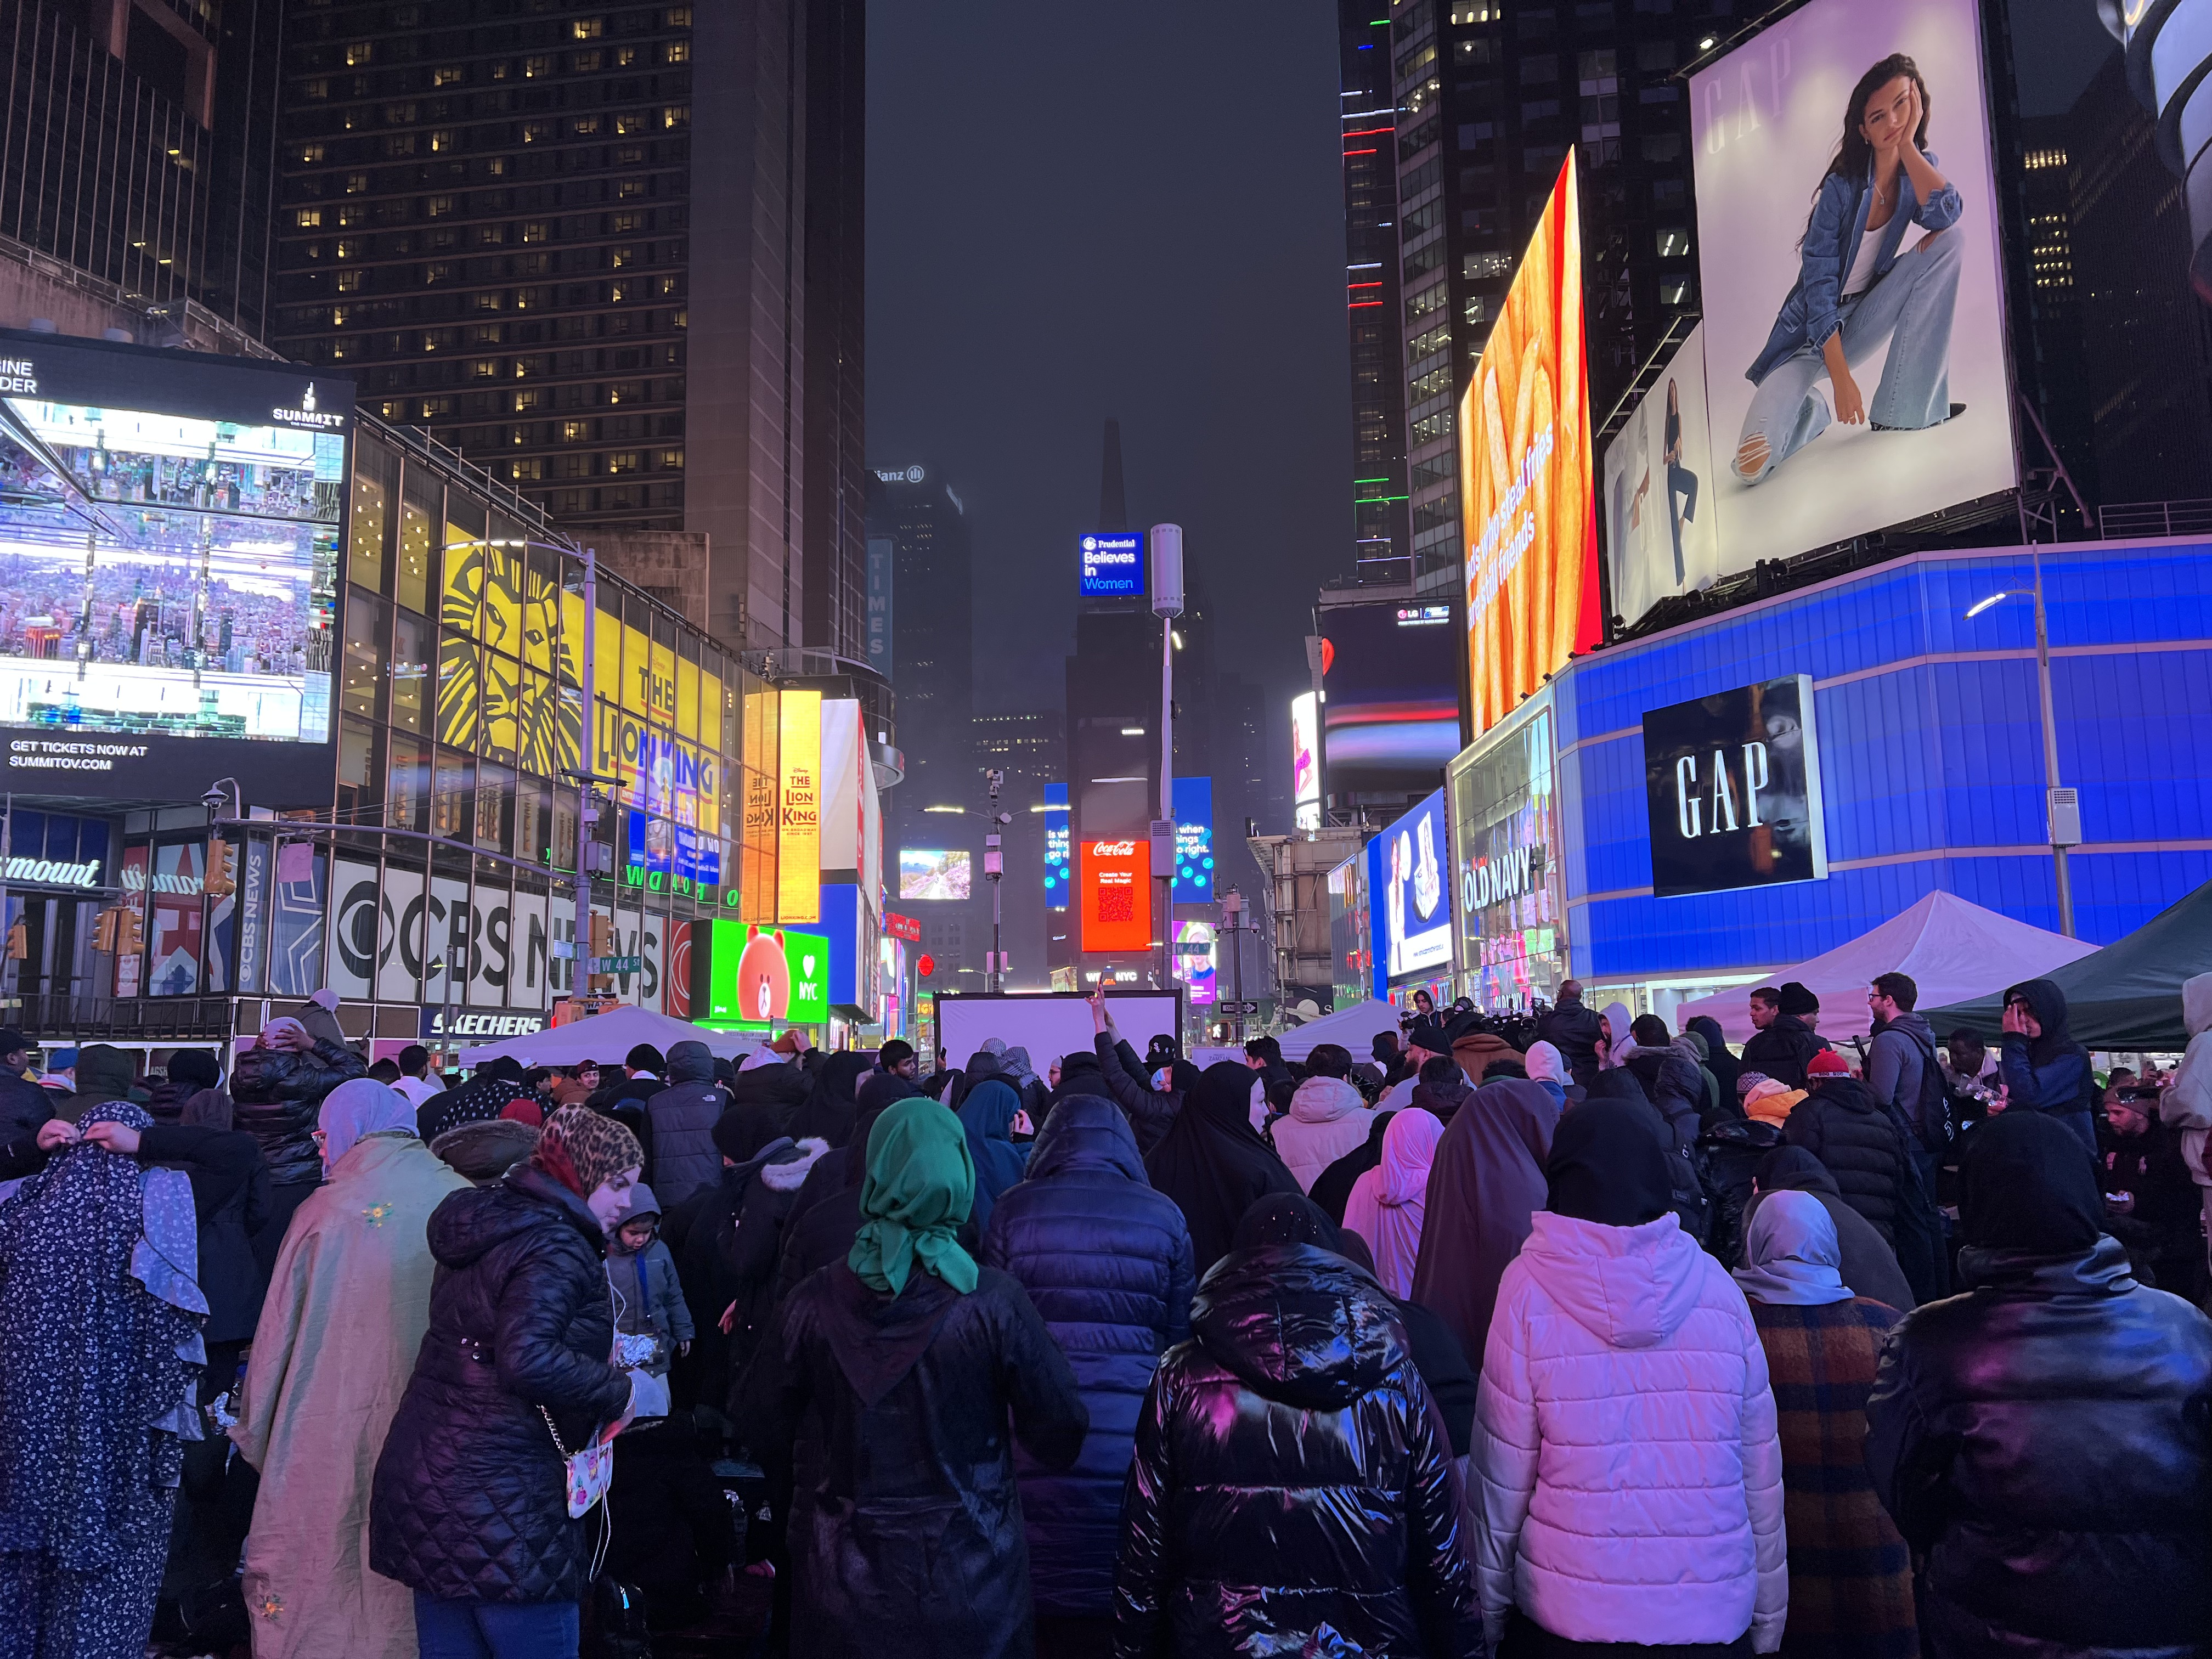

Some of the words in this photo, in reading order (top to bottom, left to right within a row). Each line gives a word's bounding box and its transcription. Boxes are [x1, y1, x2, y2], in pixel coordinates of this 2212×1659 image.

[1704, 38, 1791, 154] GAP
[0, 359, 33, 377] INE
[273, 408, 344, 427] SUMMIT
[874, 470, 904, 482] ianz
[1481, 514, 1499, 561] who
[1500, 458, 1525, 529] steal
[1526, 422, 1553, 487] fries
[1098, 539, 1135, 548] Prudential
[1084, 551, 1135, 563] Believes
[1085, 565, 1096, 576] in
[1468, 595, 1481, 632] are
[1481, 557, 1498, 611] still
[1499, 510, 1534, 585] friends
[1084, 578, 1134, 590] Women
[868, 554, 885, 654] TIMES
[639, 665, 673, 712] THE
[599, 690, 657, 772] LION
[10, 741, 39, 752] GET
[40, 742, 95, 754] TICKETS
[97, 744, 128, 755] NOW
[129, 746, 148, 757] AT
[9, 755, 112, 770] SUMMITOV.COM
[789, 776, 810, 785] THE
[786, 789, 813, 805] LION
[1676, 741, 1769, 839] GAP
[782, 808, 816, 826] KING
[1048, 830, 1056, 838] is
[1179, 825, 1204, 833] when
[1049, 851, 1061, 860] go
[1185, 845, 1209, 855] right.
[245, 855, 261, 919] NEWS
[1465, 865, 1491, 913] OLD
[1491, 843, 1531, 903] NAVY
[241, 922, 257, 961] CBS
[399, 893, 515, 987] CBS
[1177, 944, 1183, 954] W
[1187, 945, 1199, 954] 44
[602, 959, 611, 971] W
[616, 958, 629, 971] 44
[1116, 972, 1137, 982] NYC
[799, 981, 817, 1001] NYC
[1437, 981, 1449, 1007] NY
[431, 1013, 543, 1036] SKECHERS
